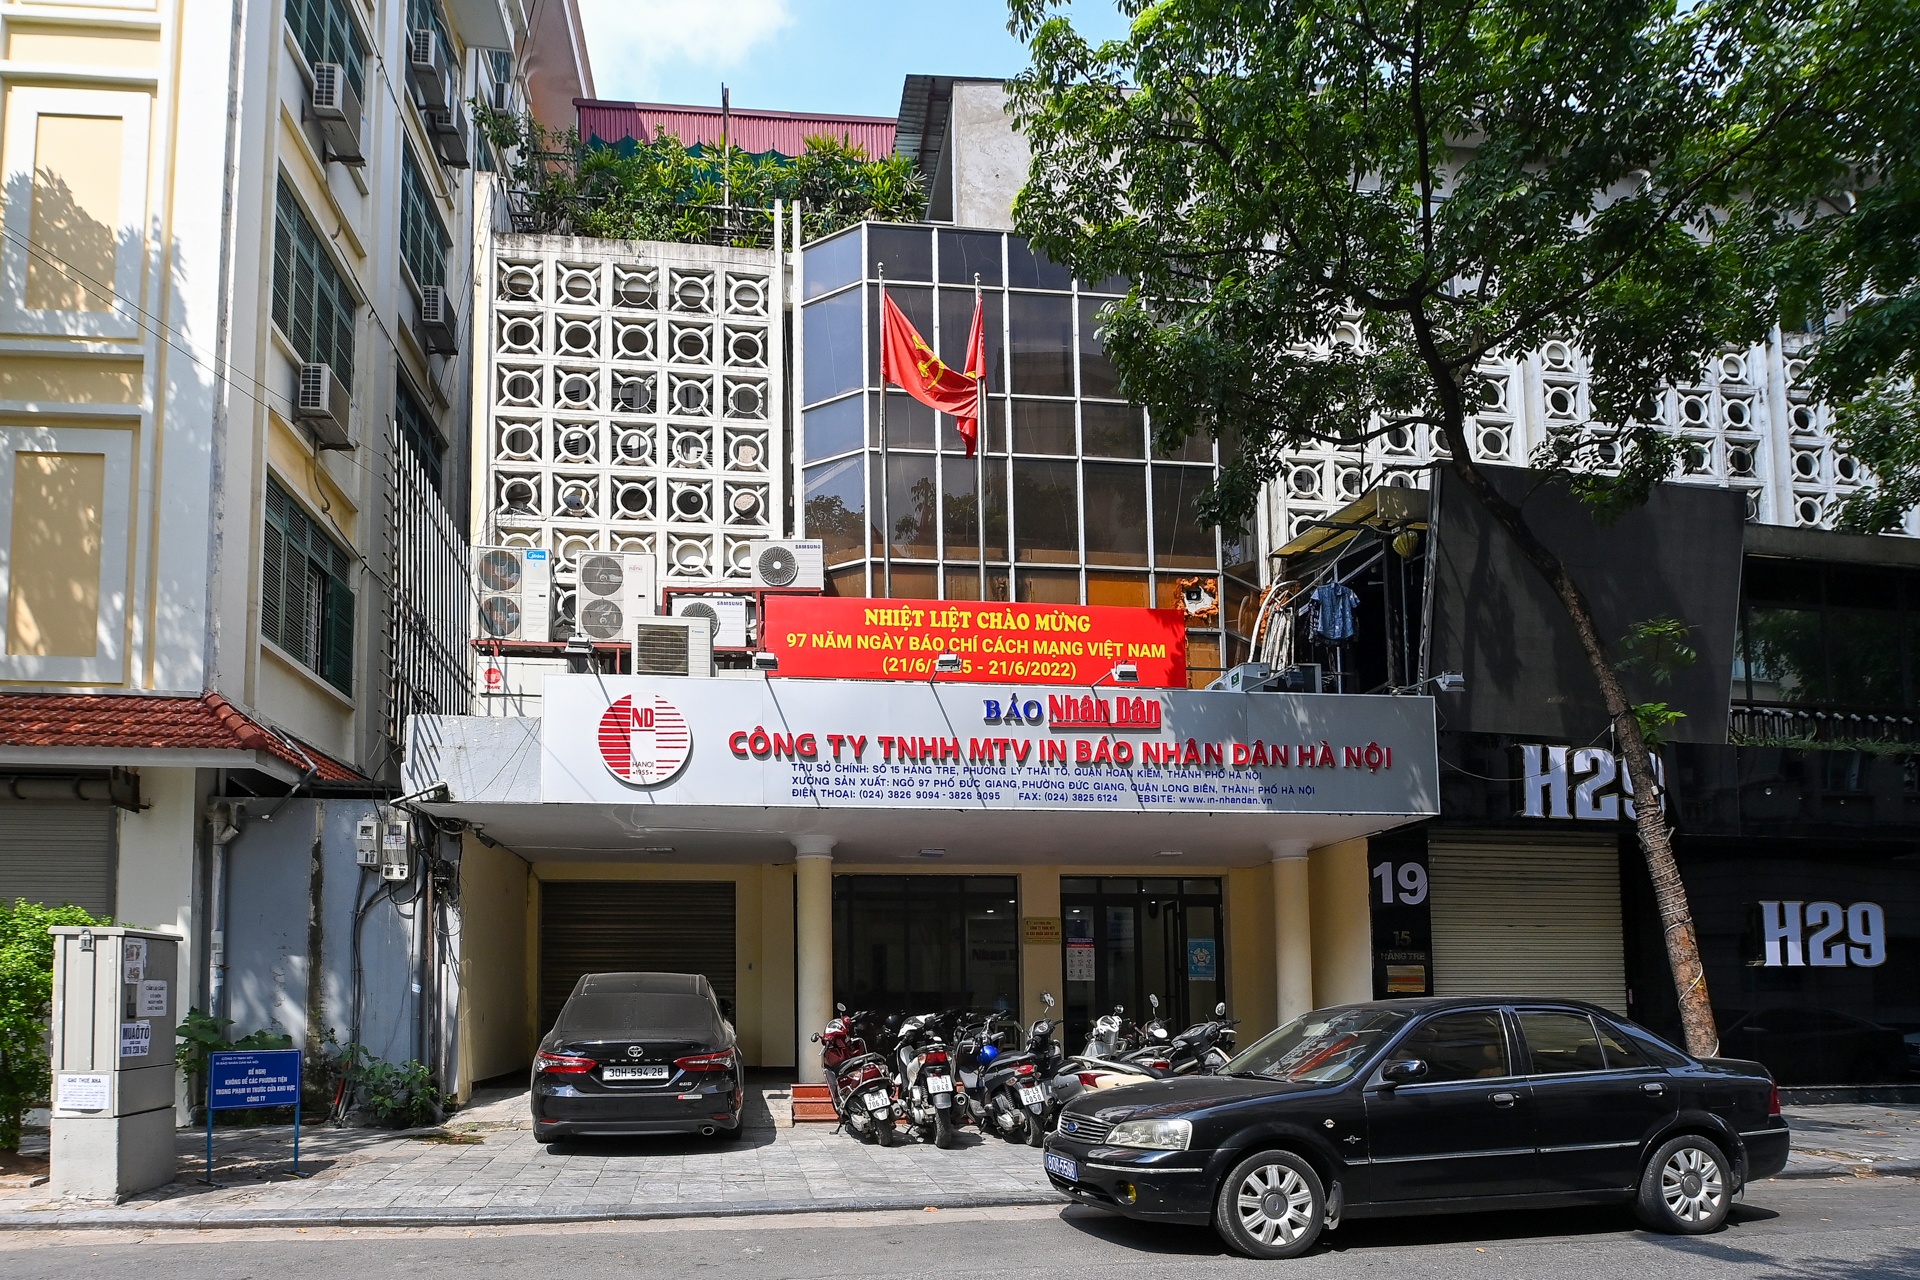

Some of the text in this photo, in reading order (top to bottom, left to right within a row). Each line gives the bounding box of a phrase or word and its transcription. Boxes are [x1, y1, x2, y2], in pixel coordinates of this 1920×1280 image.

[864, 604, 1091, 632] NHIỆT LIỆT CHÀO MỪNG
[786, 630, 1166, 659] 97 NĂM NGÀY BÁO CHÍ CÁCH MẠNG VIỆT NAM
[882, 656, 972, 675] (21/6/5
[988, 660, 1077, 680] 21/6/2022)
[632, 708, 654, 728] ND
[982, 692, 1161, 724] BÁO Nhân Dân
[728, 726, 1392, 773] CÔNG TY TNHH MTV IN BÁO NHÂN DÂN HÀ NỘI
[791, 763, 813, 774] TRỤ
[816, 760, 831, 773] SỞ
[835, 763, 869, 774] CHÍNH:
[872, 762, 887, 774] SỐ
[890, 766, 900, 774] 15
[936, 766, 959, 776] TRE,
[963, 764, 1006, 776] PHƯỜNG
[1074, 767, 1102, 778] QUẬN
[1137, 767, 1163, 779] KIẾM,
[1205, 768, 1226, 779] PHỐ
[1229, 769, 1242, 780] HÀ
[1245, 771, 1262, 781] NỘI
[791, 773, 1315, 796] XƯỞNG SẢN XUẤT: NGÕ 97 PHỐ ĐỨC GIANG, PHƯỜNG ĐỨC GIANG, QUẬN LONG BIÊN, THÀNH PHỐ HÀ NỘI
[791, 787, 817, 799] ĐIỆN
[821, 789, 856, 800] THOẠI:
[859, 790, 884, 800] (024)
[888, 790, 912, 799] 3826
[916, 790, 940, 799] 9094
[948, 792, 973, 800] 3826
[976, 792, 1001, 800] 9095
[1018, 792, 1042, 801] FAX:
[1044, 792, 1069, 802] (024)
[1072, 794, 1095, 802] 3825
[1098, 794, 1118, 802] 6124
[1138, 794, 1176, 803] EBSITE:
[1373, 861, 1428, 905] 19
[1393, 930, 1412, 946] 15
[1759, 901, 1887, 967] H29
[1408, 952, 1426, 960] TRE
[609, 1067, 664, 1078] 30H-594.28
